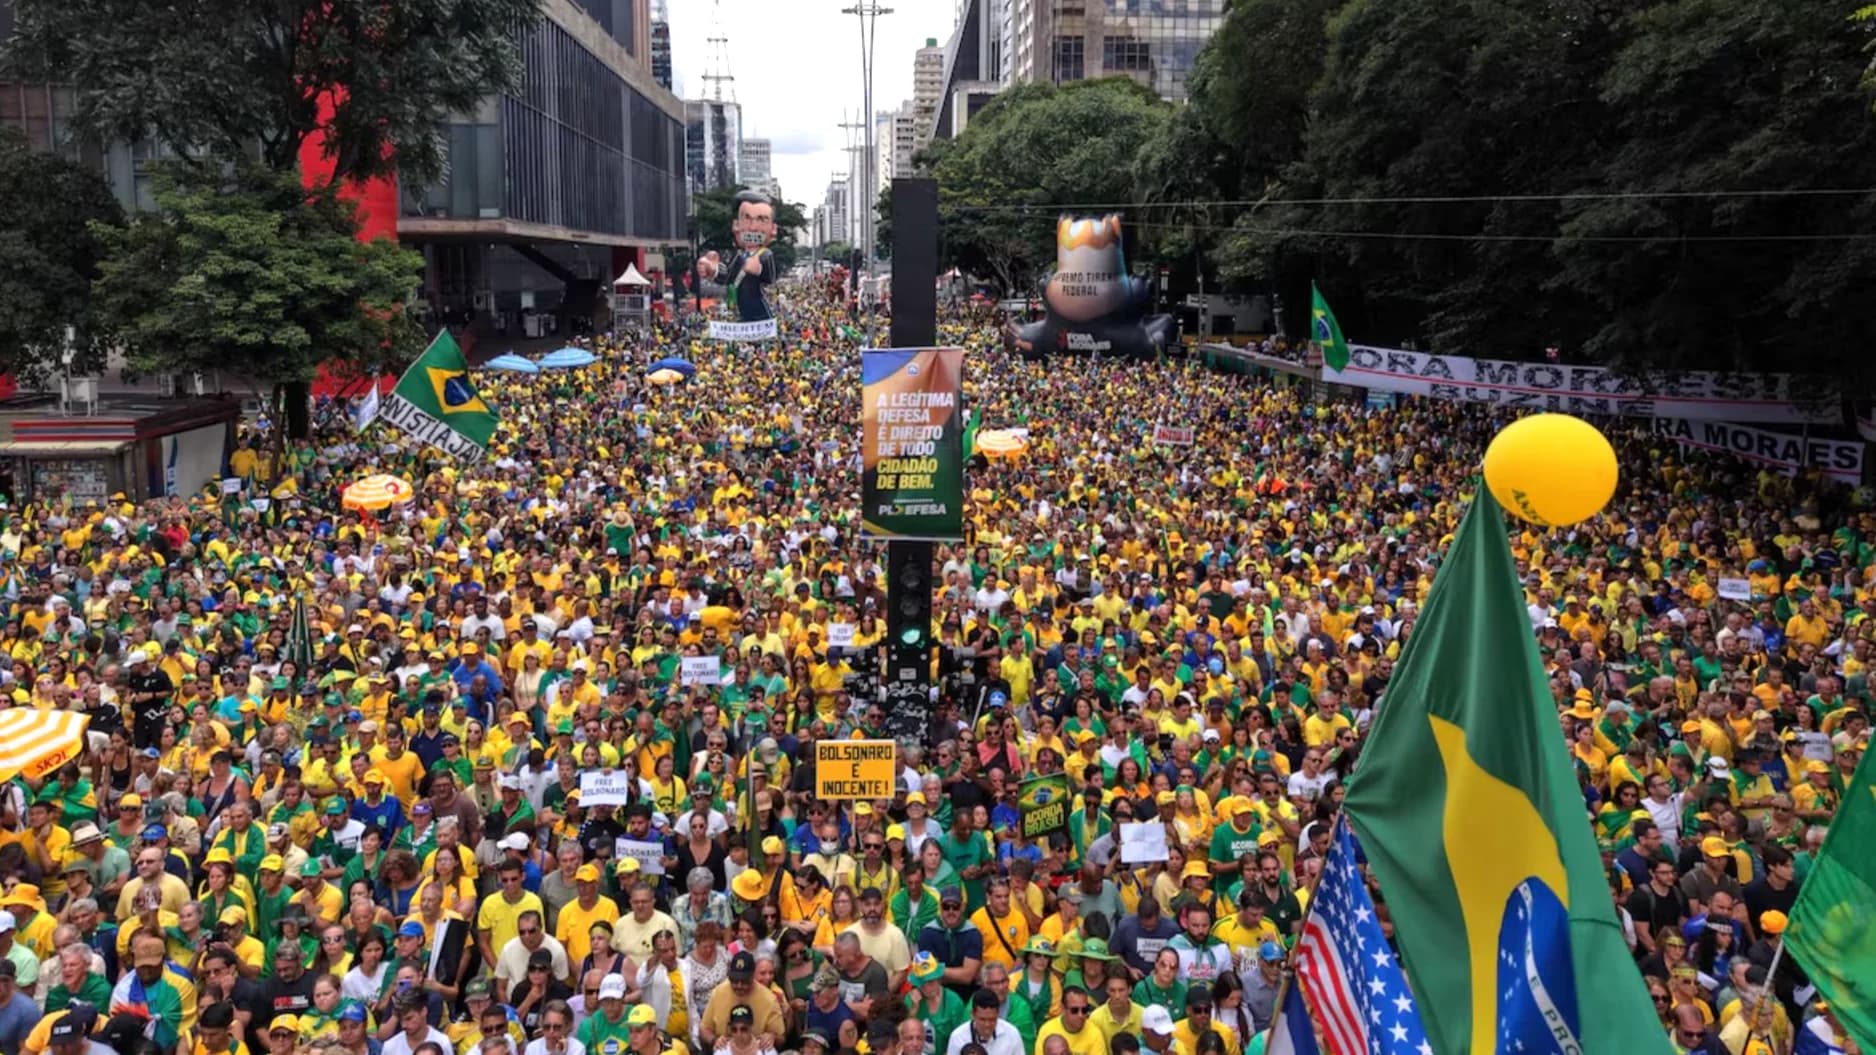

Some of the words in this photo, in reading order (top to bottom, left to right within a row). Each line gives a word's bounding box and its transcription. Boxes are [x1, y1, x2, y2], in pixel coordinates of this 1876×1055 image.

[1063, 285, 1097, 296] FEDERAL
[1350, 348, 1454, 380] ORA
[877, 393, 886, 407] A
[892, 389, 954, 408] LEGÍTIMA
[379, 394, 452, 450] ANISTIA
[877, 409, 930, 423] DEFESA
[878, 422, 887, 440] É
[891, 426, 943, 440] DIREITO
[878, 442, 896, 456] DE
[901, 441, 935, 456] TODO
[1656, 416, 1694, 441] RA
[1705, 422, 1858, 469] MORAES
[877, 456, 938, 473] CIDADÃO
[876, 475, 896, 489] DE
[899, 474, 934, 489] BEM.
[820, 745, 892, 761] BOLSONARO
[594, 778, 613, 787] FREE
[582, 786, 626, 798] BOLSONARO
[1025, 803, 1063, 824] ACORDA
